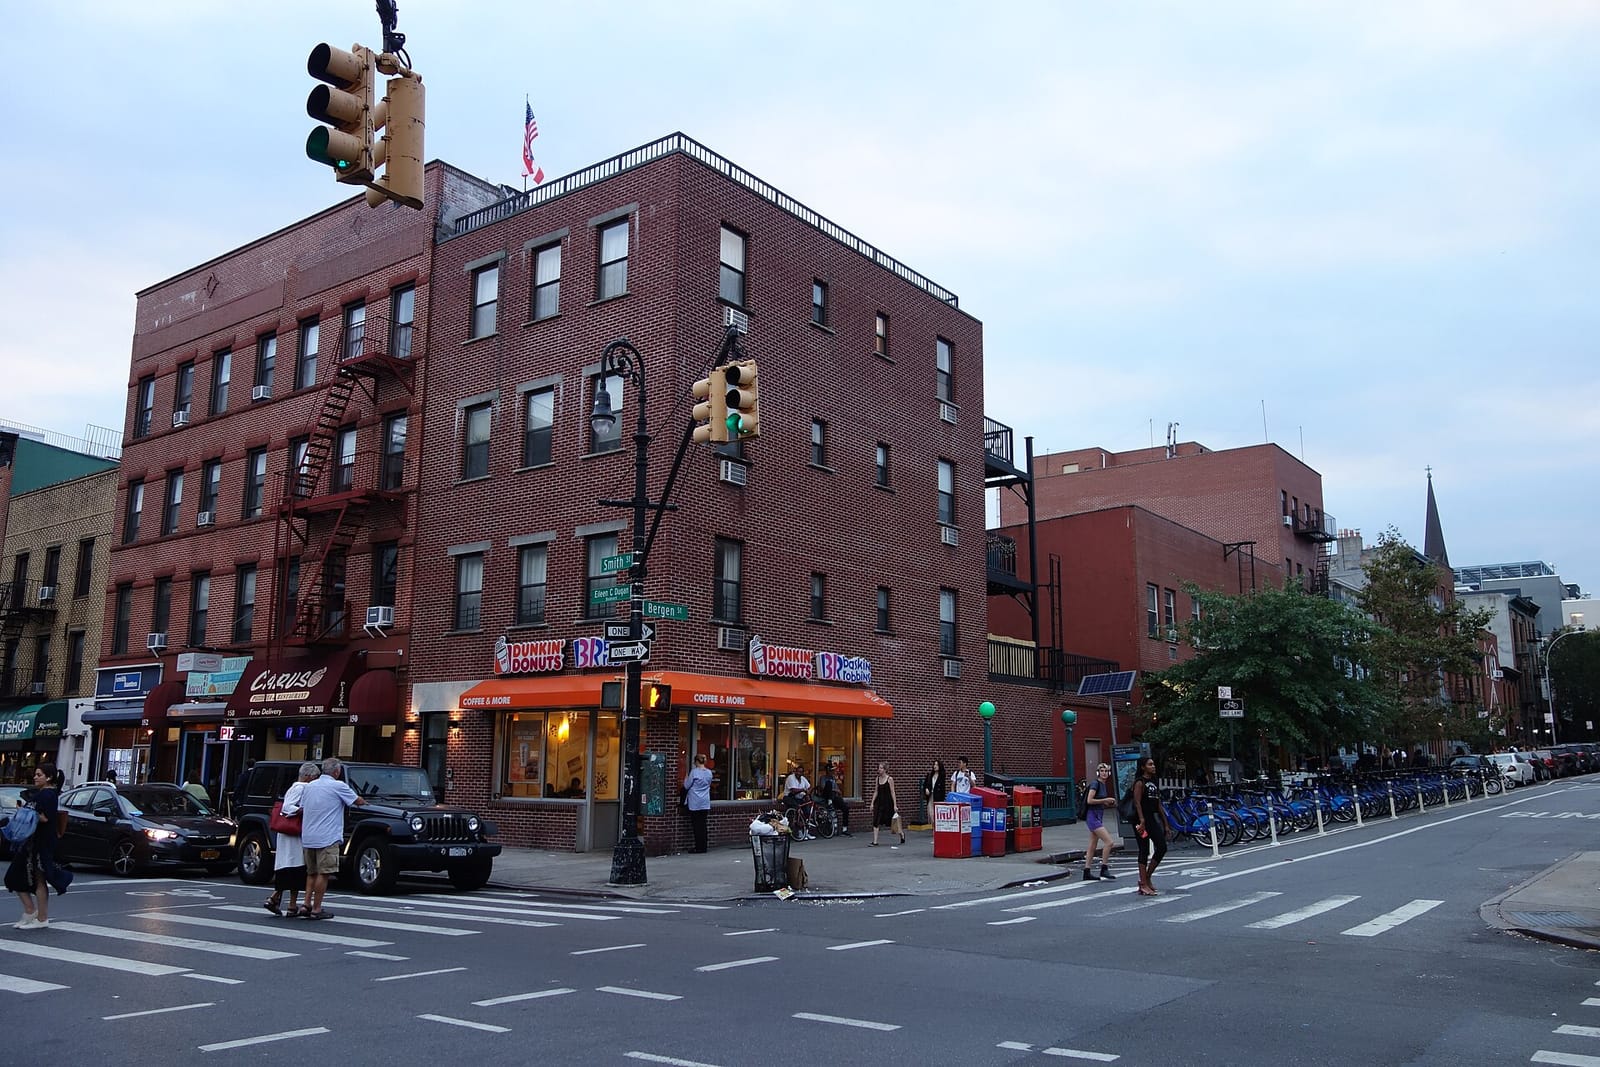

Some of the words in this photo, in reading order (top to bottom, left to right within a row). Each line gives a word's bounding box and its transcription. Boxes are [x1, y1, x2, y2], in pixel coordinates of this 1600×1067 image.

[603, 557, 624, 571] Smith
[594, 590, 609, 599] Eileen
[609, 588, 614, 596] C
[614, 587, 629, 597] Dugan
[648, 603, 675, 617] Bergen
[612, 627, 628, 636] ONE
[512, 640, 565, 657] DUNKIN'
[614, 648, 626, 656] ONE
[631, 646, 643, 655] WAY
[768, 647, 813, 663] DUNKIN'
[512, 655, 562, 672] DONUTS
[768, 661, 812, 679] DONUTS
[462, 697, 485, 706] COFFEE
[485, 697, 490, 705] &
[491, 696, 511, 704] MORE
[693, 693, 718, 703] COFFEE
[719, 696, 725, 704] &
[726, 696, 745, 705] MORE
[261, 708, 282, 716] Delivery
[6, 719, 30, 733] SHOP
